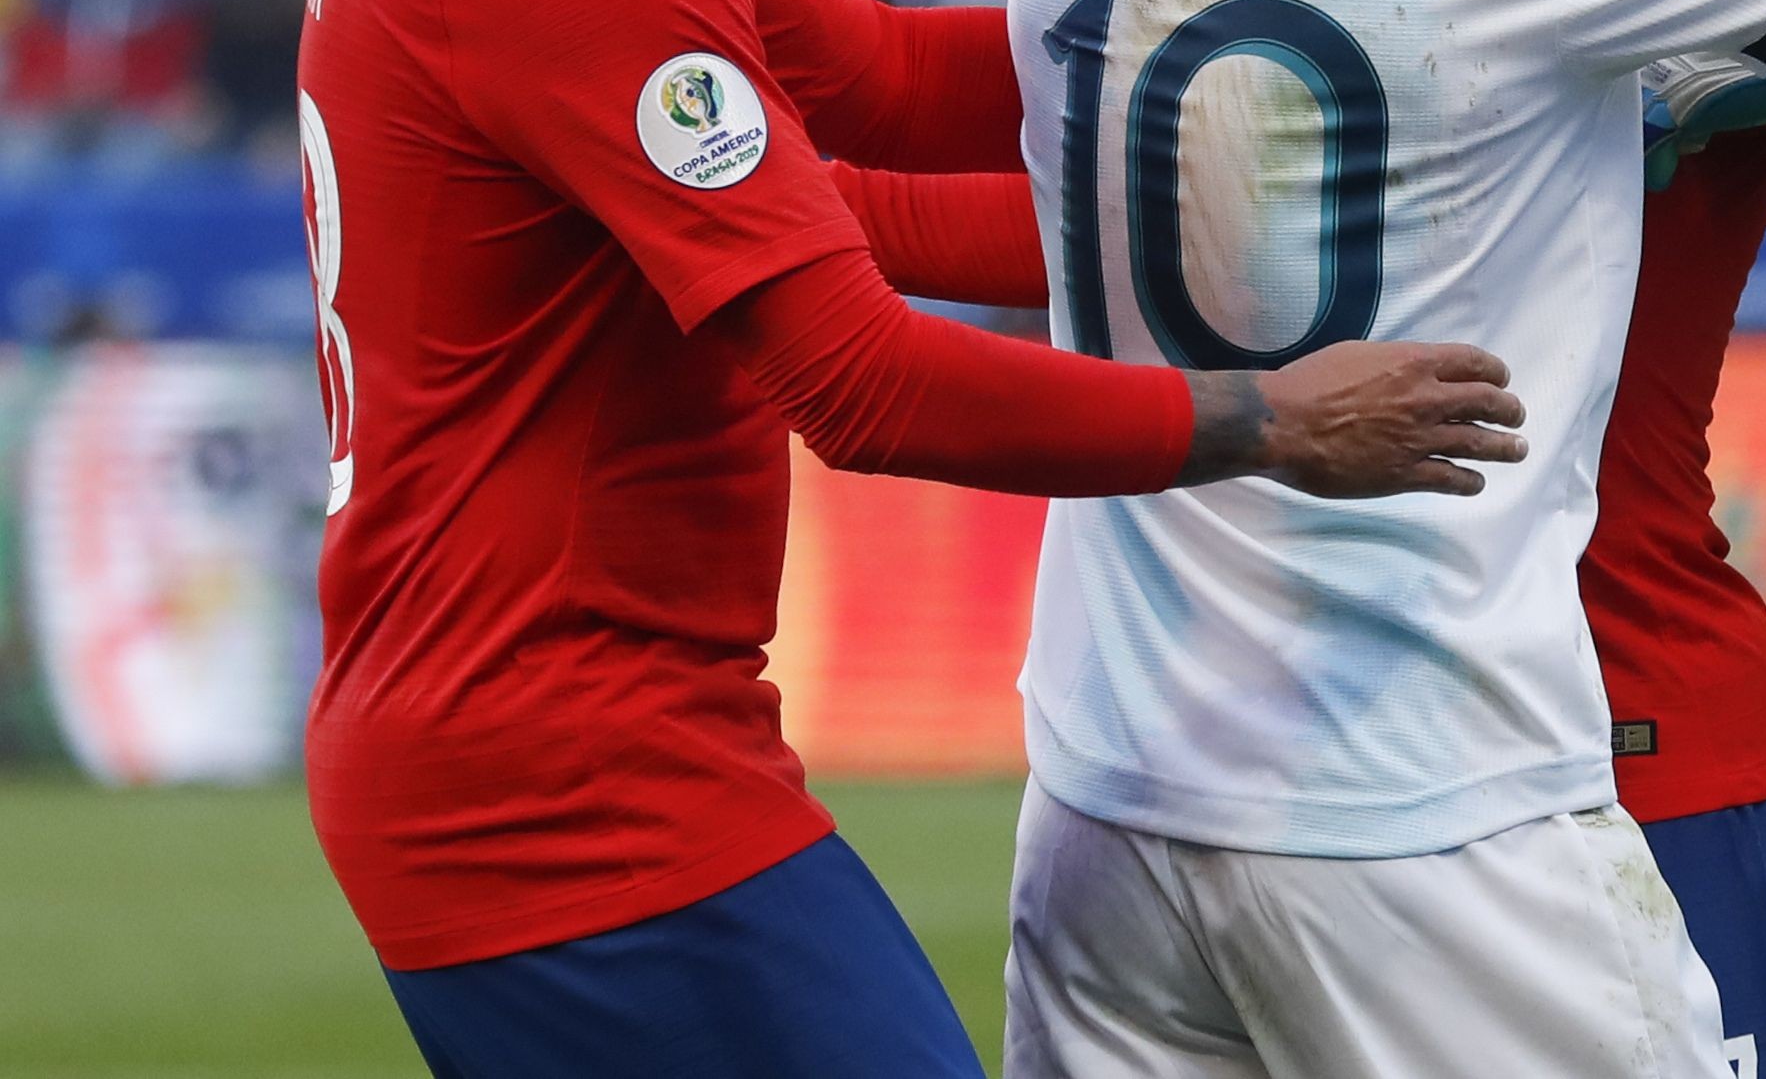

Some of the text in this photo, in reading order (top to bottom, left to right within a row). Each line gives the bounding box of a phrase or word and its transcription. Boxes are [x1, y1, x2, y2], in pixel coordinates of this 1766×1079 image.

[673, 154, 710, 178] COPA
[710, 127, 763, 160] AMERICA
[735, 144, 760, 164] 2019
